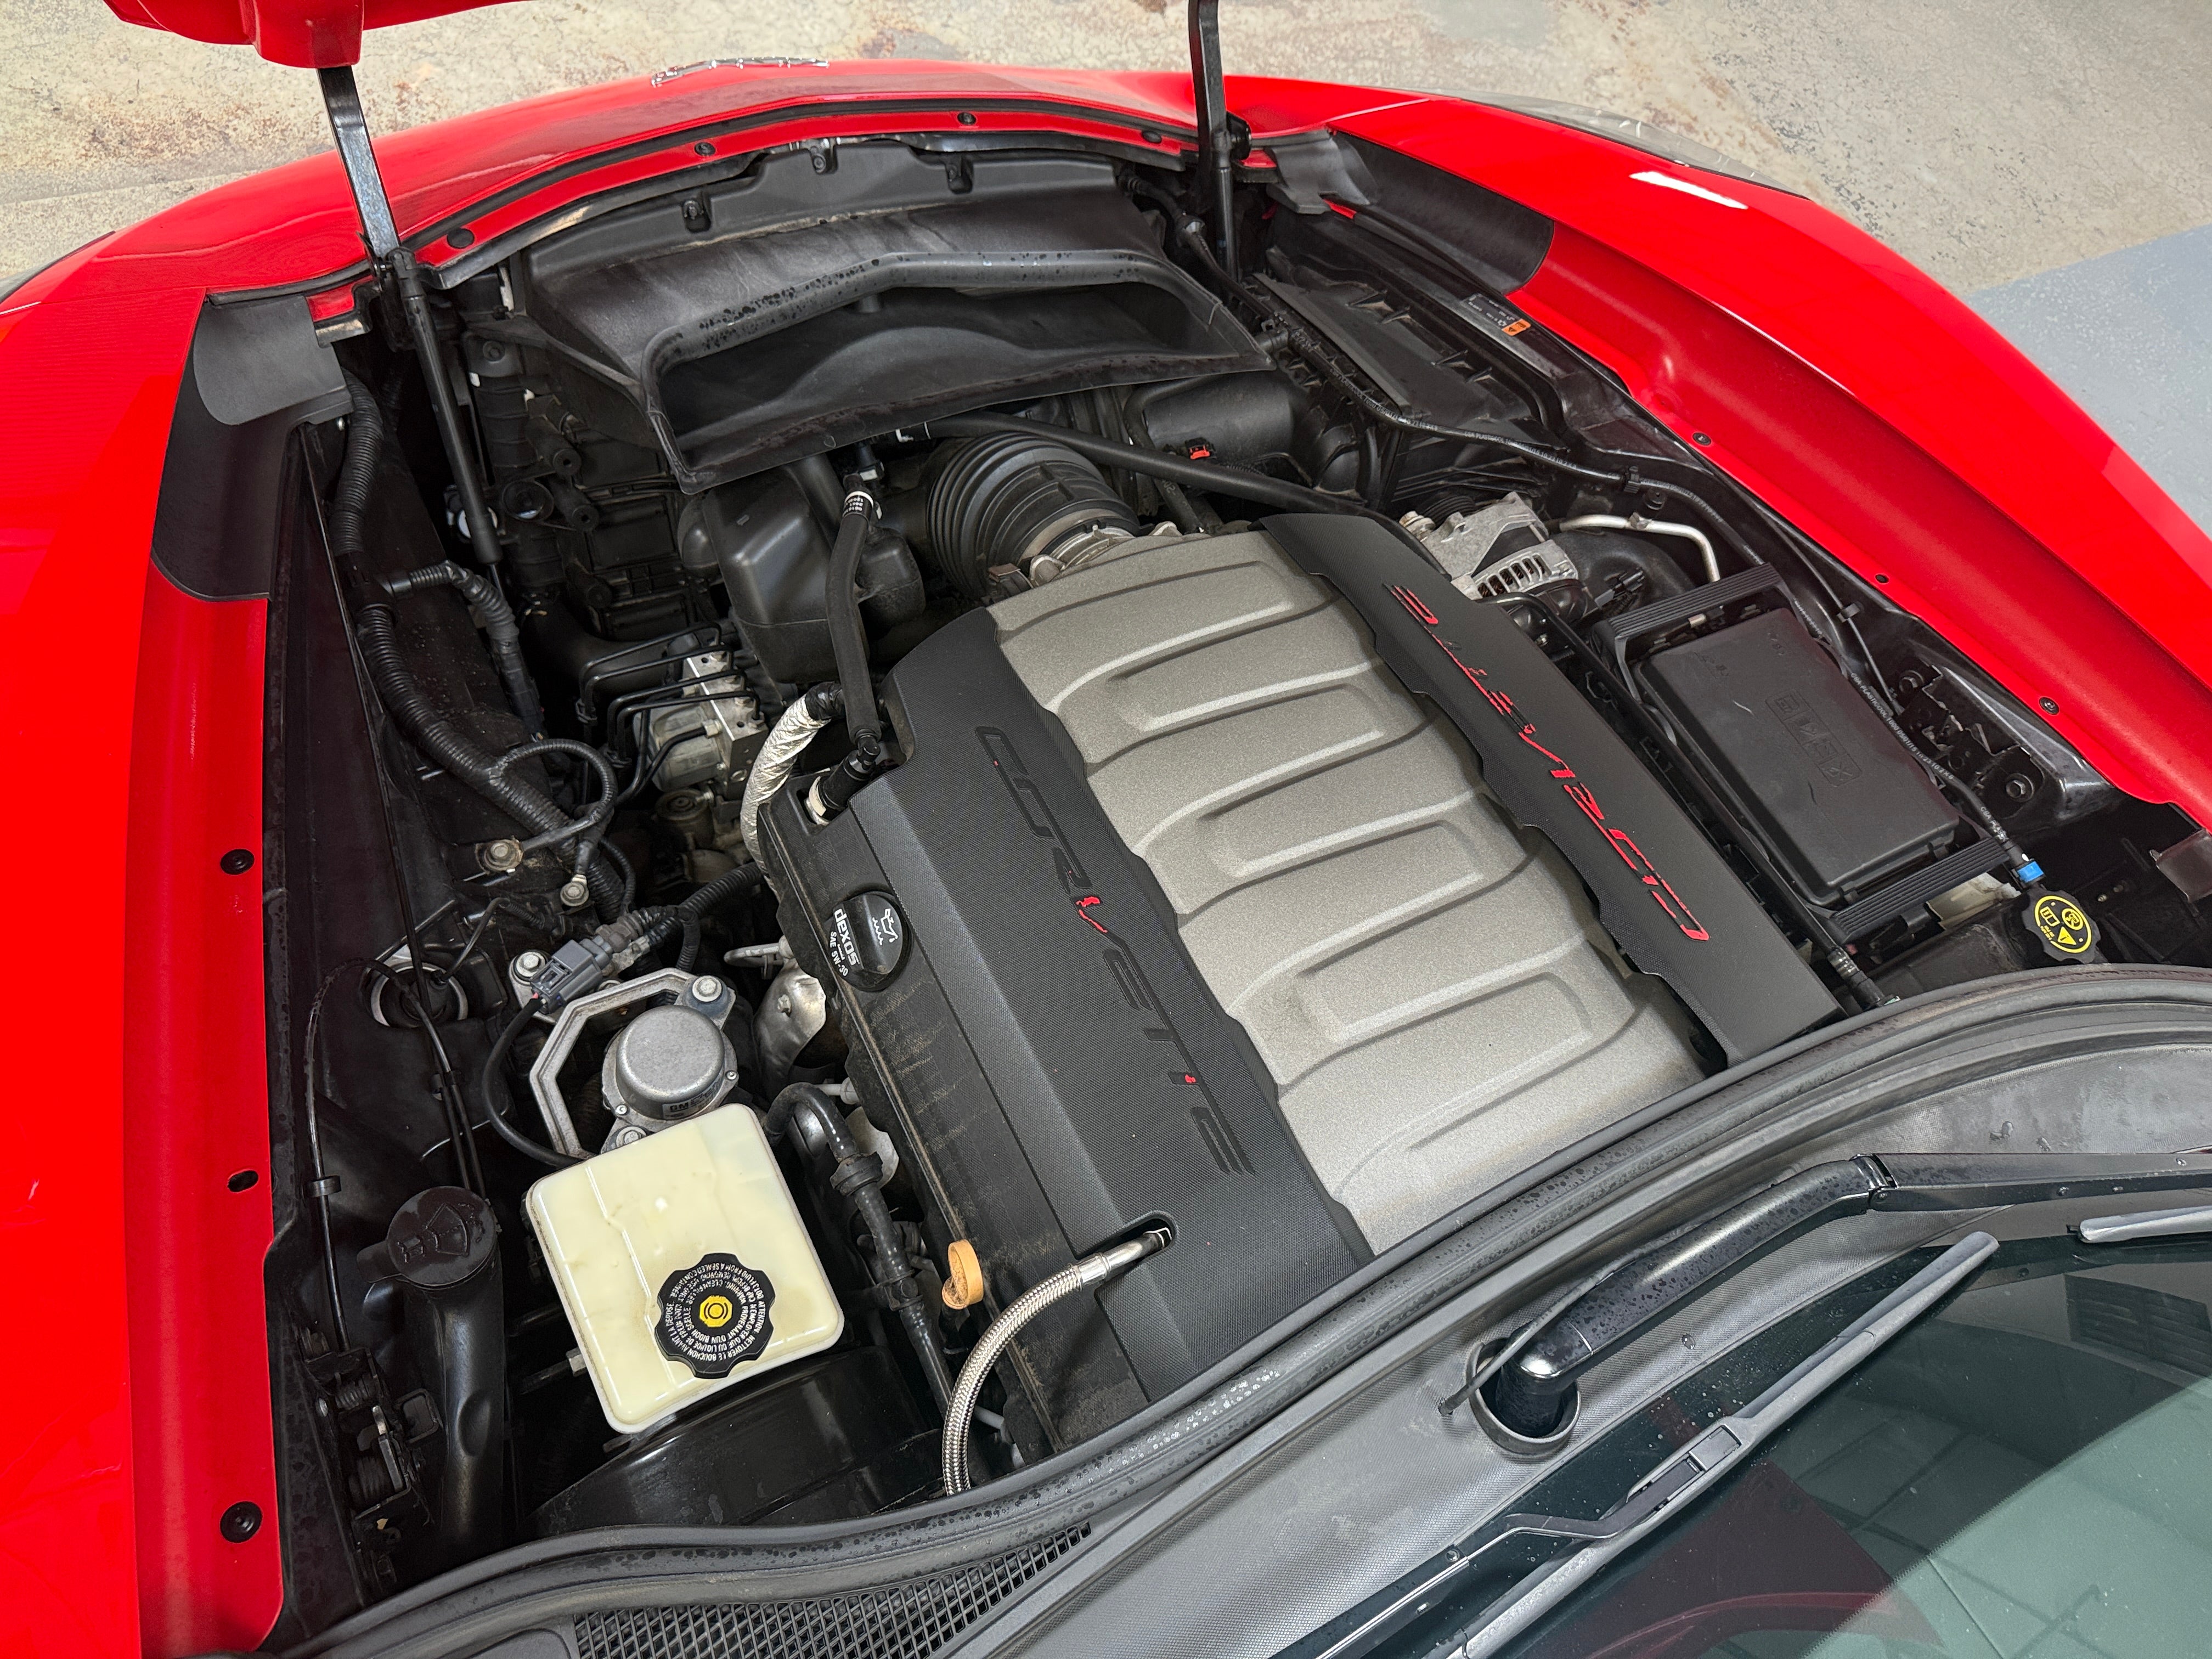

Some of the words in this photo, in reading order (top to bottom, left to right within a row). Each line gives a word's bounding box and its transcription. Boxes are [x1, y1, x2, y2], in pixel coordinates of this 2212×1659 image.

[1382, 583, 1709, 942] CORVETTE
[833, 908, 860, 966] dexos
[975, 726, 1254, 1174] CORVETTE
[831, 950, 849, 977] 5W-30
[670, 1102, 689, 1111] GM
[728, 1306, 748, 1340] PROVENANT
[685, 1336, 695, 1345] DE
[691, 1329, 710, 1343] BIDON
[711, 1335, 727, 1344] D'UN
[729, 1338, 741, 1347] QUE
[672, 1335, 690, 1352] AVANT
[693, 1340, 717, 1352] LIQUIDE
[718, 1343, 727, 1351] DU
[727, 1335, 755, 1357] NETTOYER
[687, 1349, 716, 1362] BOUCHON
[718, 1352, 726, 1361] LE
